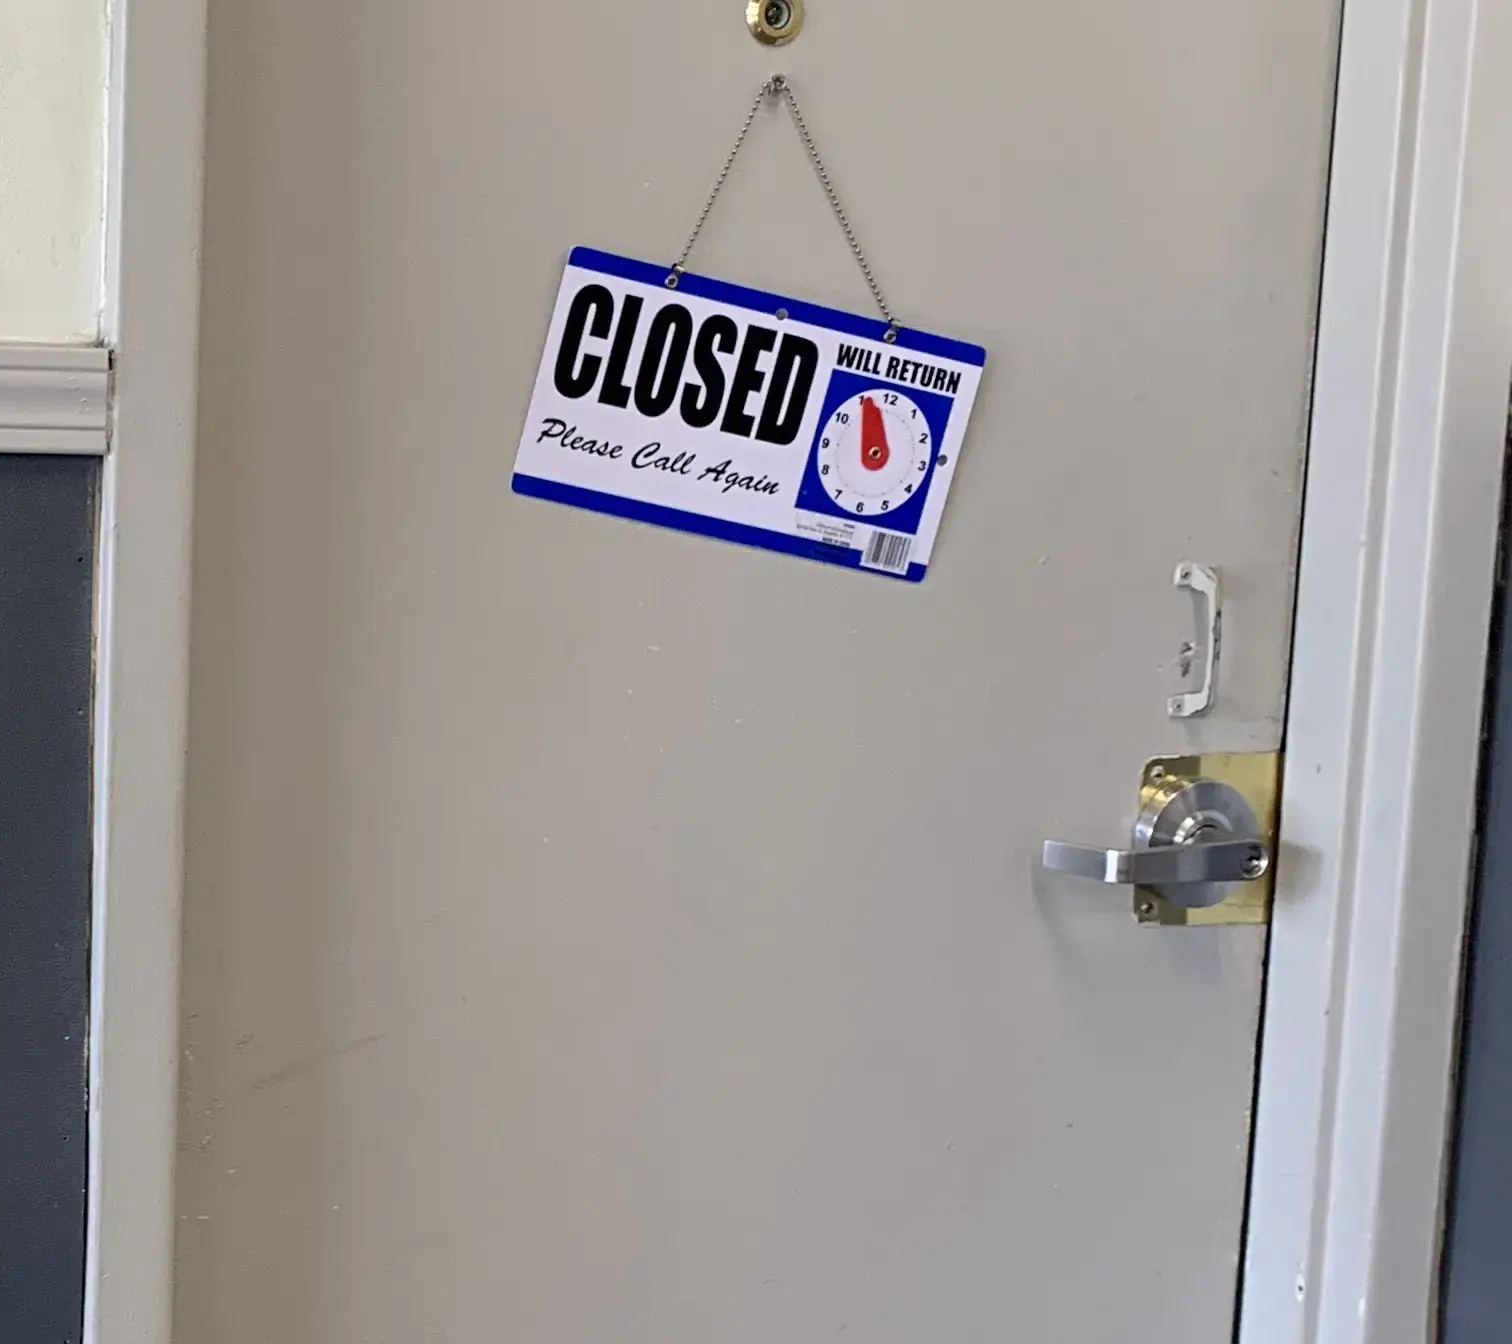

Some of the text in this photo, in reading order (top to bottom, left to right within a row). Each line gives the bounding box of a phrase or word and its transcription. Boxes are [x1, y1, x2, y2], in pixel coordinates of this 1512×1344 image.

[553, 283, 819, 446] CLOSED
[836, 343, 962, 395] WILL RETURN
[883, 393, 899, 406] 12
[835, 412, 849, 425] 10
[910, 408, 917, 419] 1
[821, 438, 830, 449] 9
[918, 432, 928, 444] 2
[537, 418, 780, 495] Please Call Again
[821, 464, 830, 476] 8
[917, 460, 927, 472] 3
[834, 488, 843, 499] 7
[904, 483, 913, 494] 4
[855, 501, 865, 513] 6
[880, 500, 890, 511] 5
